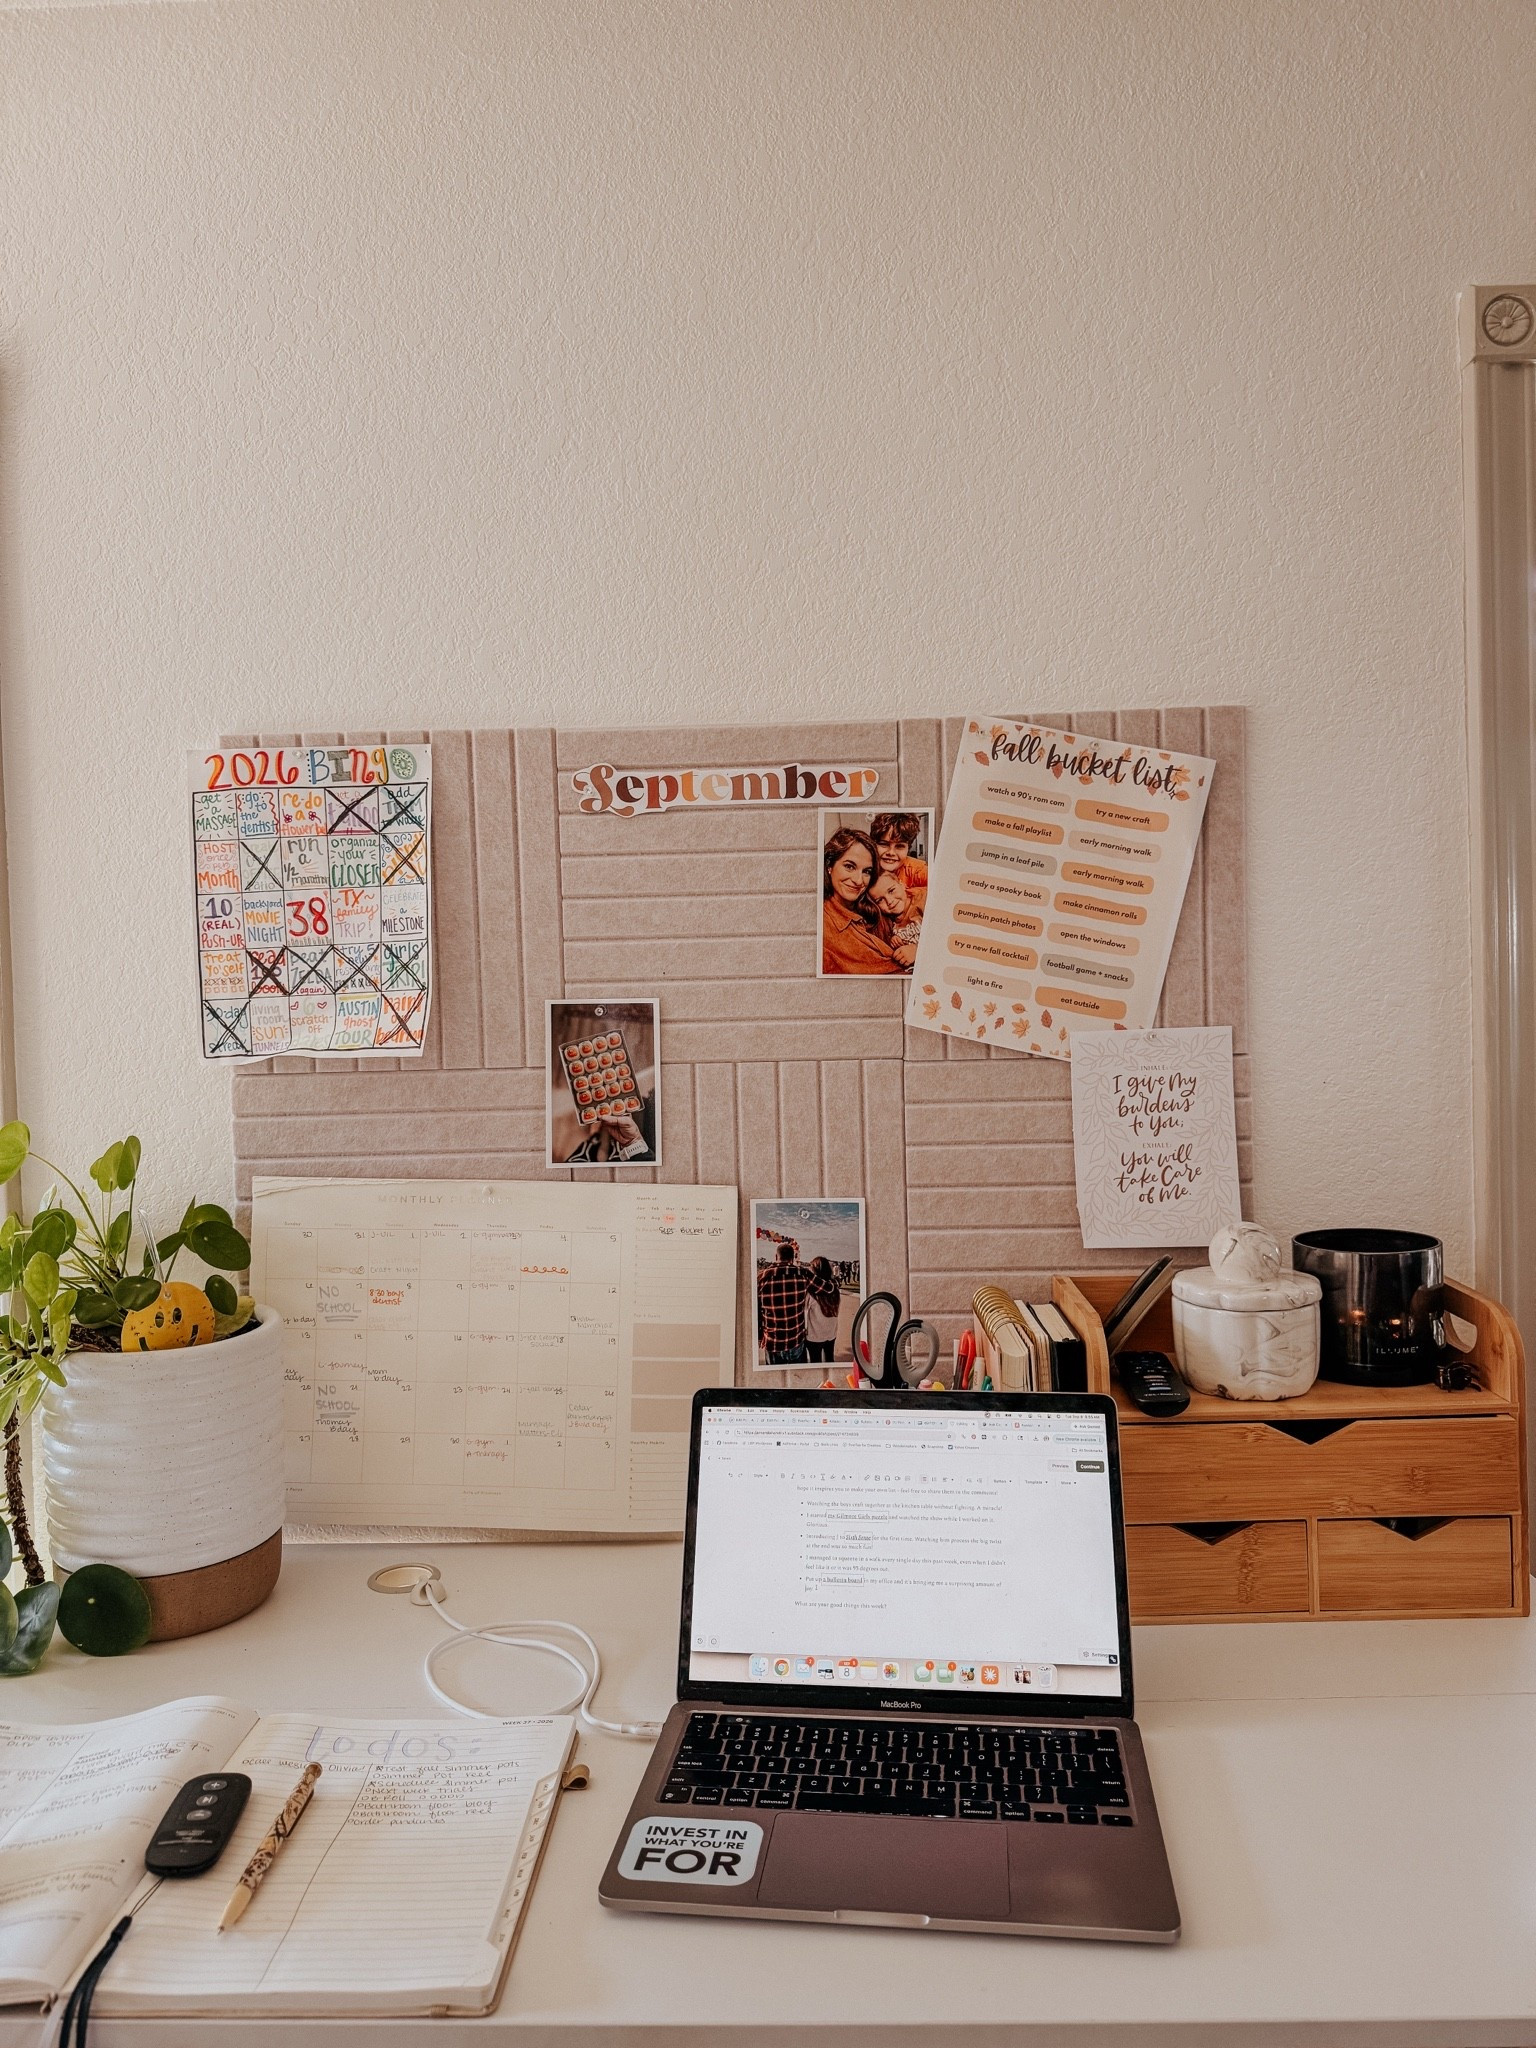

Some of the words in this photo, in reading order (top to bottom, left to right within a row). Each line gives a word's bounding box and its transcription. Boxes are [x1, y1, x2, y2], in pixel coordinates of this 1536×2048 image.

[204, 750, 299, 790] 2026
[991, 733, 1041, 764] fall
[1046, 743, 1131, 783] bucket
[1133, 757, 1182, 792] list
[572, 764, 877, 817] September
[987, 786, 1009, 795] watch
[1017, 791, 1031, 800] 90's
[200, 794, 221, 809] get
[245, 792, 259, 809] go
[254, 801, 267, 812] to
[283, 791, 322, 809] re-do
[211, 806, 221, 815] a
[240, 812, 258, 821] the
[294, 809, 306, 820] a
[1096, 808, 1107, 817] try
[1114, 813, 1131, 821] new
[1132, 816, 1150, 825] craft
[196, 813, 238, 831] MASSAGE
[240, 820, 277, 835] dentist
[984, 818, 1005, 828] make
[1013, 822, 1025, 831] fall
[1025, 826, 1052, 837] playlist
[203, 843, 235, 854] HOST
[287, 838, 323, 856] run
[331, 837, 380, 851] organize
[1080, 837, 1099, 847] early
[1100, 842, 1132, 854] morning
[1133, 848, 1152, 857] walk
[298, 853, 311, 865] a
[338, 850, 366, 866] your
[981, 849, 1000, 860] jump
[1016, 856, 1030, 865] leaf
[1031, 860, 1045, 868] pile
[198, 869, 240, 892] Month
[284, 863, 299, 882] 1/2
[1072, 869, 1092, 879] early
[1093, 873, 1125, 885] morning
[1125, 880, 1144, 888] walk
[383, 891, 425, 905] CELEBRATE
[967, 879, 988, 889] ready
[996, 885, 1022, 897] spooky
[1023, 890, 1042, 900] book
[244, 898, 283, 913] backyard
[338, 889, 364, 908] TX
[204, 897, 233, 919] 10
[286, 896, 329, 937] 38
[333, 904, 379, 922] family
[1062, 899, 1083, 909] make
[1084, 904, 1120, 916] cinnamon
[1120, 911, 1138, 920] rolls
[202, 917, 241, 932] (REAL)
[245, 911, 281, 925] MOVIE
[382, 916, 425, 933] MILESTONE
[957, 909, 989, 920] pumpkin
[990, 916, 1010, 925] patch
[1011, 920, 1036, 930] photos
[247, 926, 285, 943] NIGHT
[335, 921, 374, 938] TRIP!
[1060, 930, 1079, 939] open
[1079, 933, 1092, 942] the
[1093, 938, 1126, 949] windows
[204, 952, 240, 963] treat
[954, 940, 965, 949] try
[972, 945, 988, 953] new
[989, 946, 1001, 955] fall
[1001, 950, 1029, 961] cocktail
[1046, 959, 1075, 971] football
[1075, 966, 1097, 976] game
[1103, 972, 1129, 983] snacks
[296, 986, 327, 996] (again)
[967, 975, 983, 985] light
[990, 981, 1003, 990] fire
[251, 1005, 280, 1016] living
[337, 997, 380, 1020] AUSTIN
[1073, 999, 1100, 1010] outside
[257, 1014, 289, 1026] room
[343, 1016, 376, 1031] ghost
[335, 1029, 373, 1046] TOUR
[1113, 1075, 1123, 1095] I
[1127, 1075, 1166, 1098] give
[1116, 1087, 1195, 1118] burdens
[1128, 1115, 1144, 1136] to
[1121, 1151, 1154, 1174] You
[1157, 1143, 1193, 1167] will
[1113, 1168, 1158, 1193] take
[1139, 1187, 1155, 1204] of
[319, 1285, 340, 1299] NO
[316, 1302, 362, 1313] SCHOOL
[317, 1384, 336, 1396] NO
[315, 1399, 360, 1411] SCHOOL
[843, 1667, 851, 1677] 8
[880, 1700, 909, 1709] MacBook
[910, 1701, 922, 1709] Pro
[646, 1825, 720, 1839] INVEST
[725, 1829, 748, 1840] IN
[644, 1837, 687, 1847] WHAT
[691, 1840, 745, 1850] YOU'RE
[633, 1847, 742, 1876] FOR
